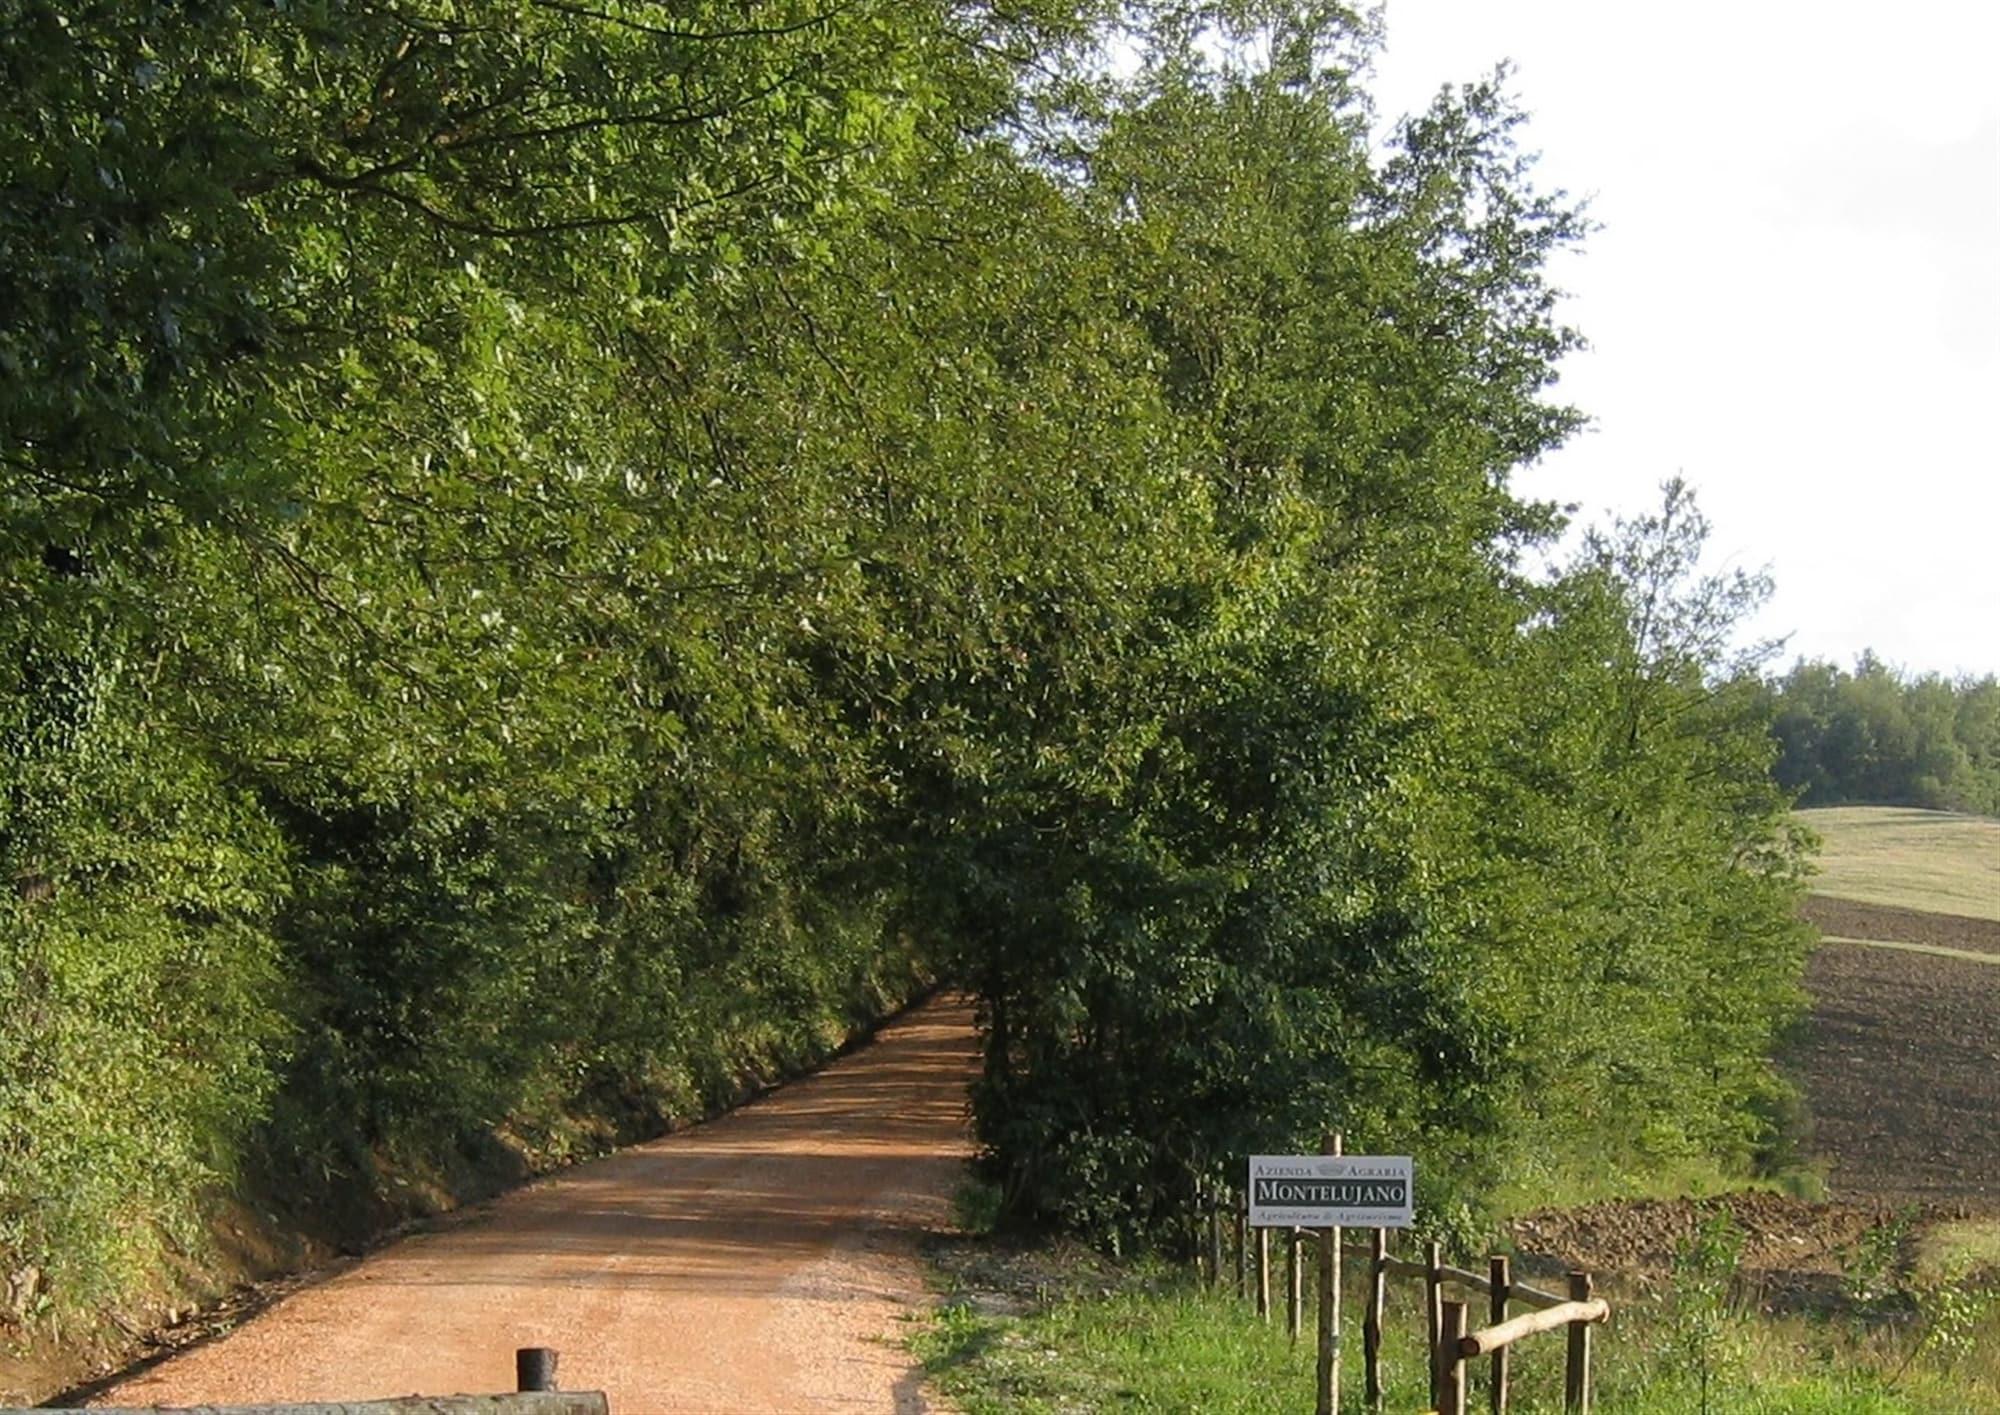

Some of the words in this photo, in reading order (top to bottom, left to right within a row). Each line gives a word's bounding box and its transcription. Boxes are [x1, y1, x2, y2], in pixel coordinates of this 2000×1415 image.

[1255, 1165, 1312, 1177] AZIENDA
[1348, 1165, 1406, 1177] AGRARIA
[1258, 1181, 1405, 1205] MONTELUJANO
